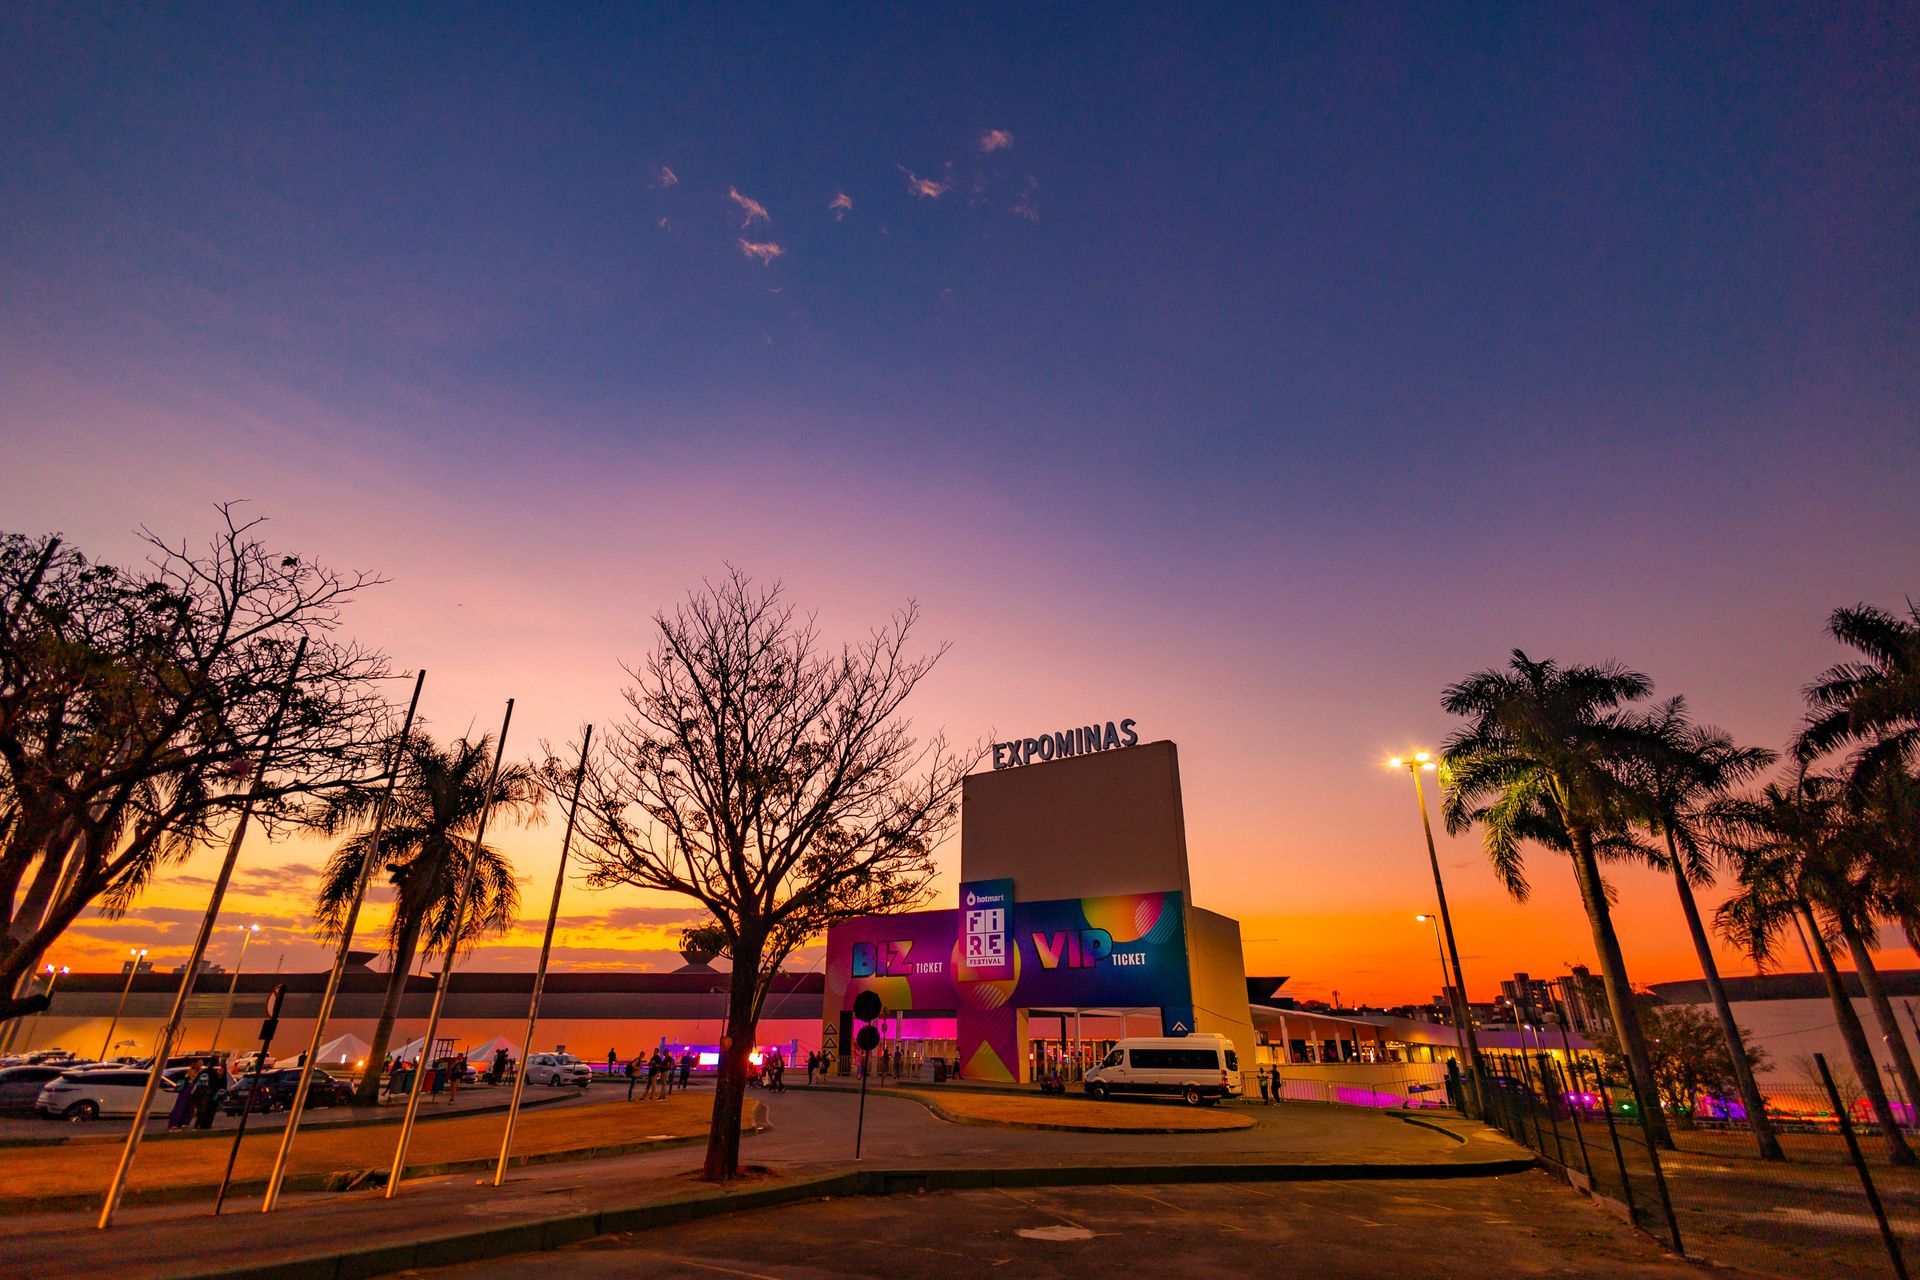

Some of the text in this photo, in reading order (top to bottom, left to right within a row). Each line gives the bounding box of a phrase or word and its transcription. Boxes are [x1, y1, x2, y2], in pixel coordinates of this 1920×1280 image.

[993, 719, 1138, 769] EXPOMINAS
[977, 895, 1004, 903] hotmart
[852, 940, 942, 977] BIZ TICKET
[1032, 928, 1146, 969] VIP TICKET
